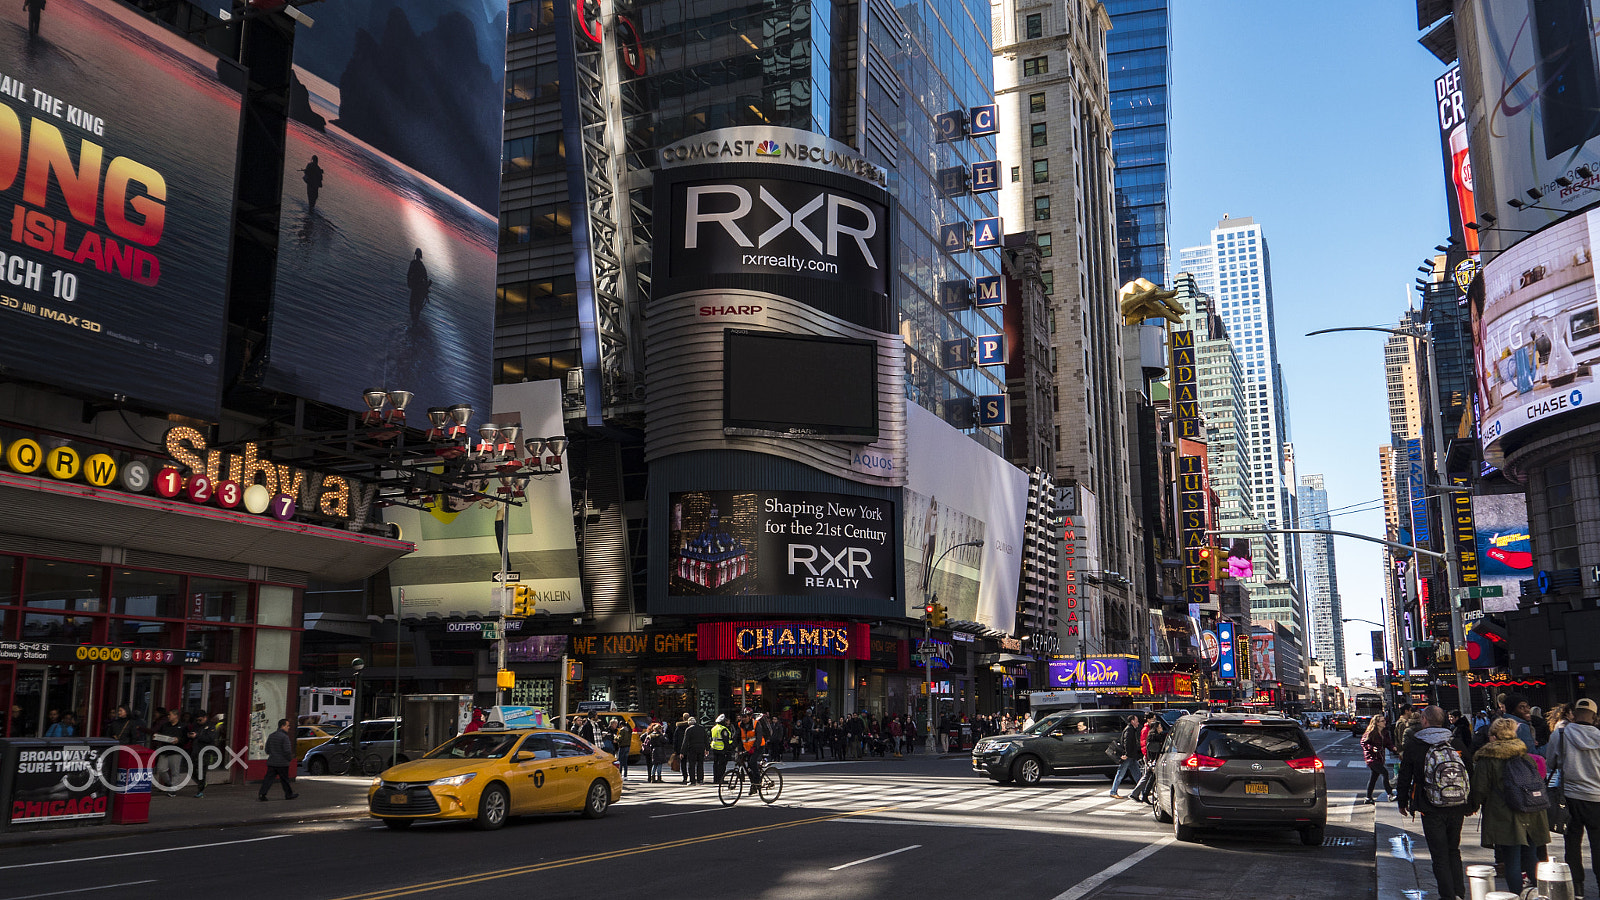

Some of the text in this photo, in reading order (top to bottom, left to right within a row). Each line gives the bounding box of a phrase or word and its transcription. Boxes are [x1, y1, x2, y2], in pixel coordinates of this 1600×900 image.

[0, 74, 104, 136] AIL THE KING
[663, 140, 754, 162] COMCAST
[685, 184, 878, 270] RXR
[10, 204, 161, 287] ISLAND
[742, 254, 838, 274] rxrrealty.com
[975, 109, 1000, 420] CHAMPS
[52, 269, 78, 302] 10
[22, 302, 36, 315] AND
[39, 307, 80, 327] IMAX
[81, 319, 101, 333] 3D
[699, 305, 763, 317] SHARP
[1174, 333, 1198, 437] MADAME
[1527, 394, 1568, 419] CHASE
[789, 427, 818, 436] SHARP
[1406, 440, 1422, 461] NEW
[853, 454, 893, 471] AQUOS
[18, 444, 293, 516] Q R W S 1 2 3 7
[166, 426, 378, 532] Subway
[765, 498, 883, 521] Shaping New York
[1412, 499, 1429, 541] STUDIOS
[765, 519, 887, 545] for the 21st Century
[788, 543, 873, 579] RXR
[1462, 551, 1478, 582] NEW
[805, 577, 860, 589] REALTY
[1064, 516, 1079, 637] AMSTERDAM
[543, 590, 571, 602] KLEIN
[1464, 609, 1485, 621] CHERS
[448, 623, 482, 631] OUTFRO
[0, 641, 17, 650] imes
[19, 642, 41, 652] Sq-42
[573, 636, 597, 655] WE
[603, 634, 648, 653] KNOW
[737, 628, 849, 654] CHAMPS
[1032, 632, 1060, 653] SEPHORA
[0, 651, 47, 660] ubway Station
[772, 648, 819, 656] SPORTS
[768, 669, 802, 680] CHAMPS
[1057, 660, 1119, 682] Aladdin
[20, 750, 97, 762] BROADWAY'S
[18, 762, 51, 774] SURE
[130, 771, 153, 782] VOICE
[12, 796, 107, 817] CHICAGO
